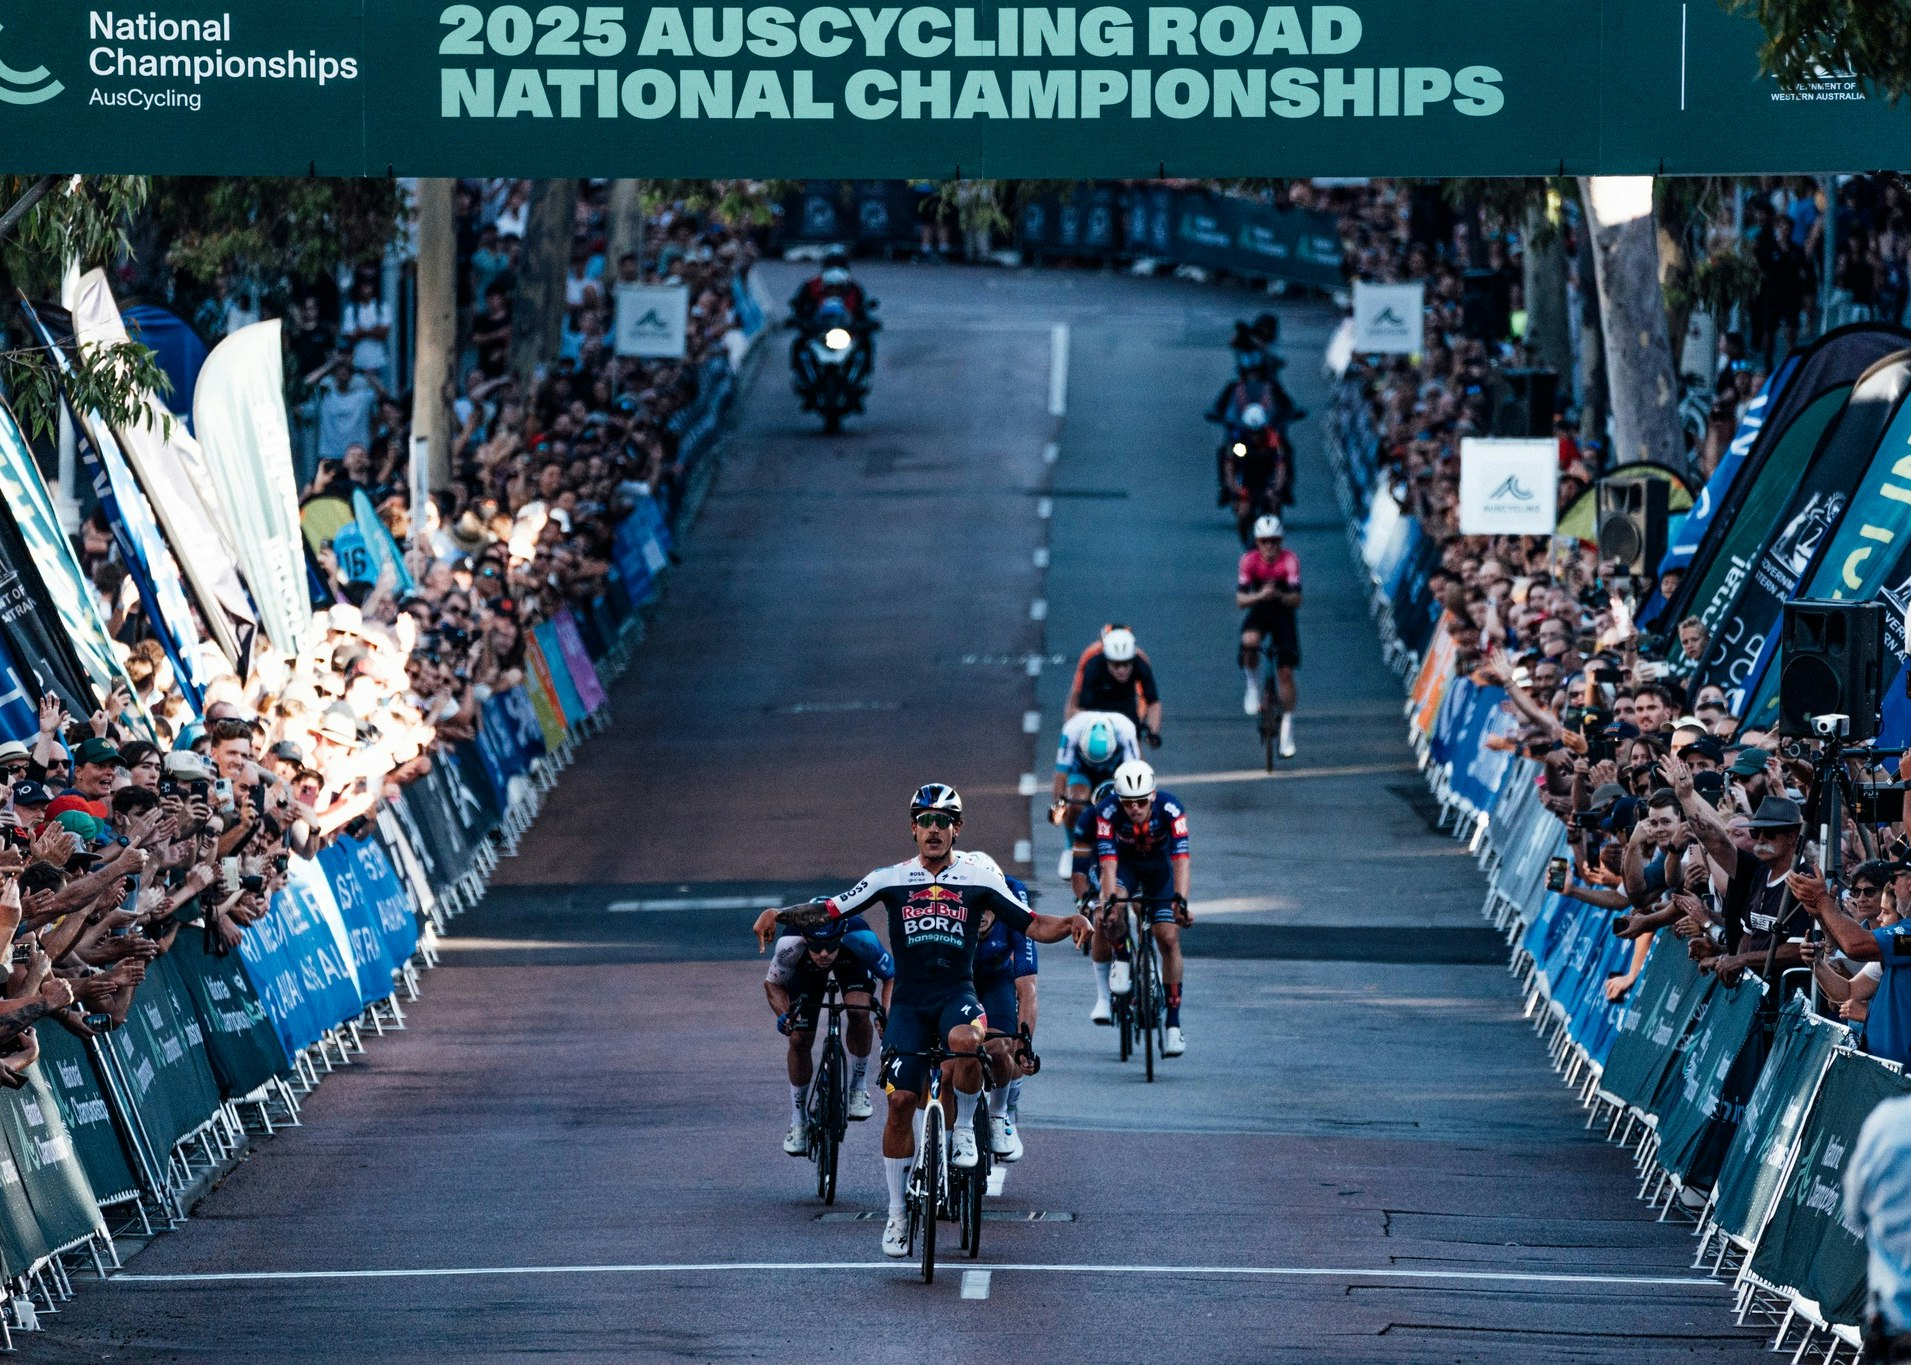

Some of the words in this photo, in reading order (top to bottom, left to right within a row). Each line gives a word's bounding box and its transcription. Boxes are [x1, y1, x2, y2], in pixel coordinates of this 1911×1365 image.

[89, 11, 231, 42] National
[439, 4, 627, 57] 2025
[637, 5, 1134, 58] AUSCYCLING
[1148, 5, 1363, 57] ROAD
[89, 47, 359, 86] Championships
[441, 68, 834, 120] NATIONAL
[845, 65, 1505, 121] CHAMPIONSHIPS
[1816, 92, 1866, 100] AUSTRALIA
[1843, 82, 1856, 90] OF
[89, 87, 202, 112] AusCycling
[839, 879, 869, 903] BOSS
[902, 902, 936, 921] Red
[936, 902, 969, 923] Bull
[903, 916, 965, 937] BORA
[908, 933, 964, 947] hansgrohe
